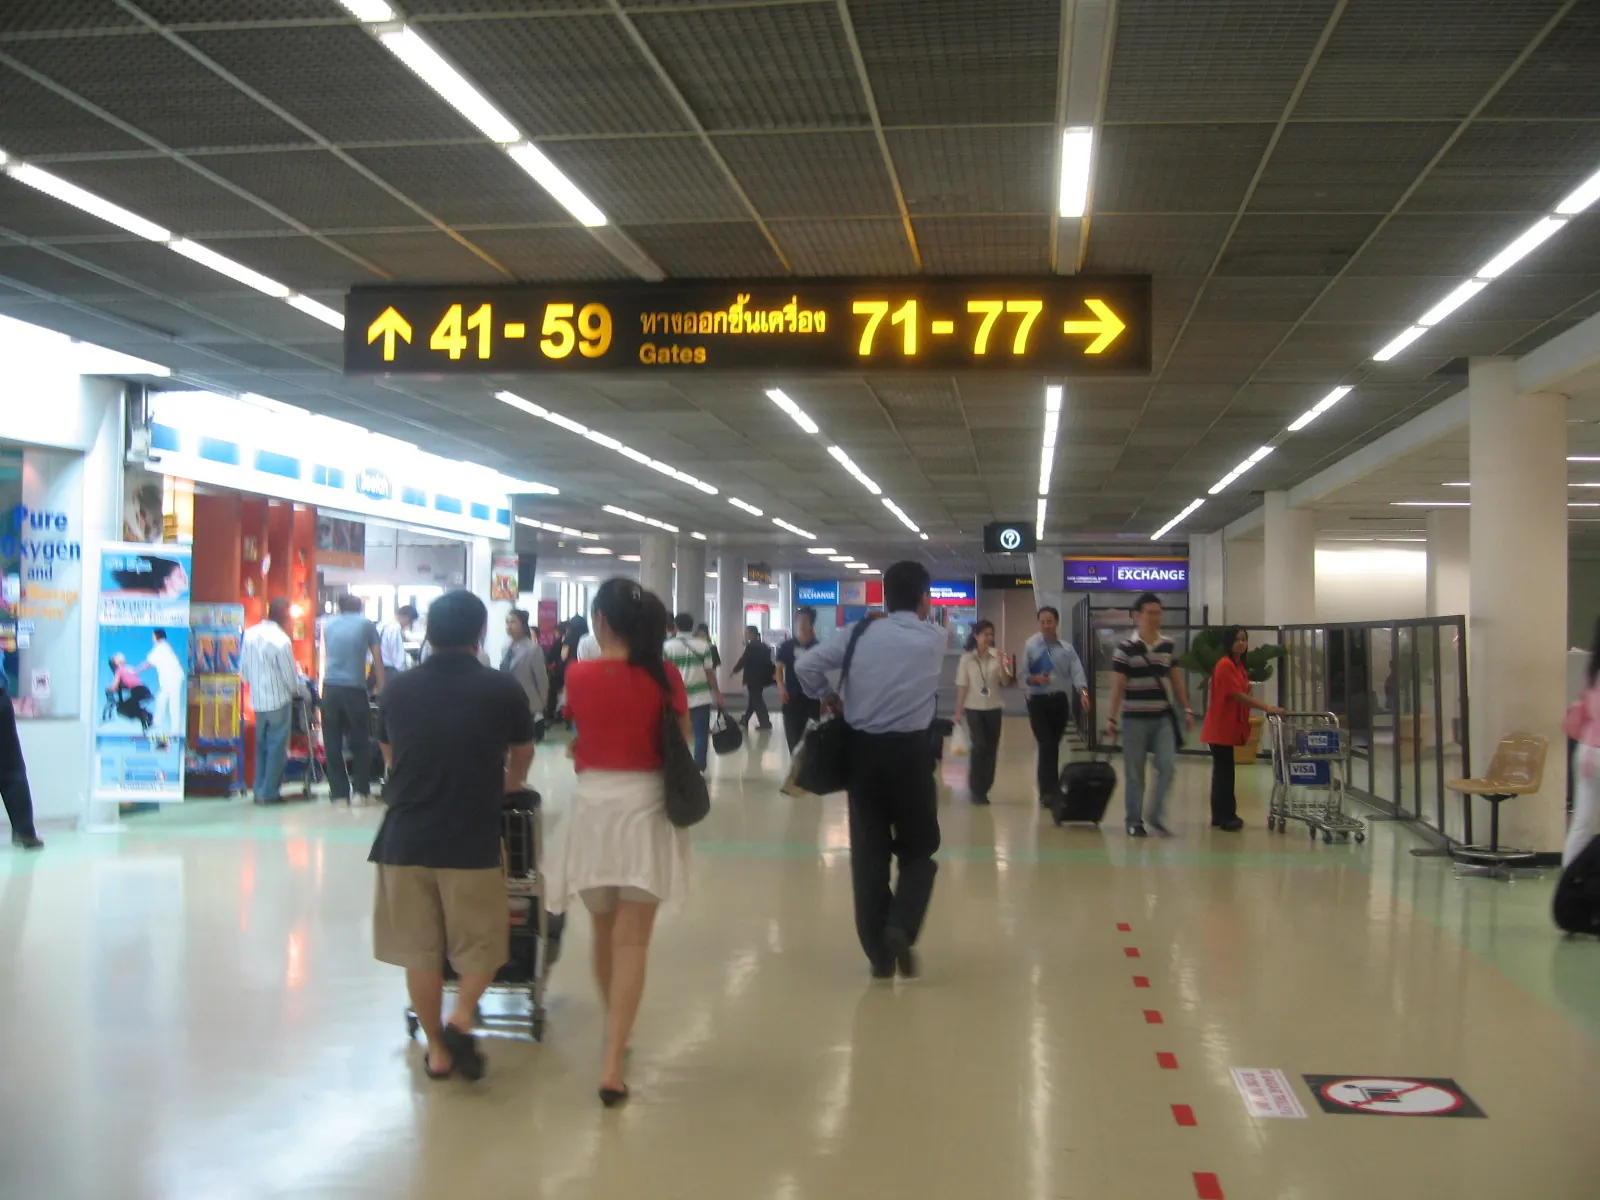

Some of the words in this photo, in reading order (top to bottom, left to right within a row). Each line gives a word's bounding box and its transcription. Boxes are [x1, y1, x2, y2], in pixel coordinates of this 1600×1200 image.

[639, 293, 826, 335] ทางออกขึ้นเครื่อง
[639, 342, 706, 364] Gates
[13, 503, 68, 532] Pure
[1, 532, 81, 565] Oxygen
[27, 563, 53, 581] and
[1117, 569, 1186, 581] EXCHANGE
[799, 591, 836, 600] EXCHANGE
[1293, 765, 1315, 773] VISA
